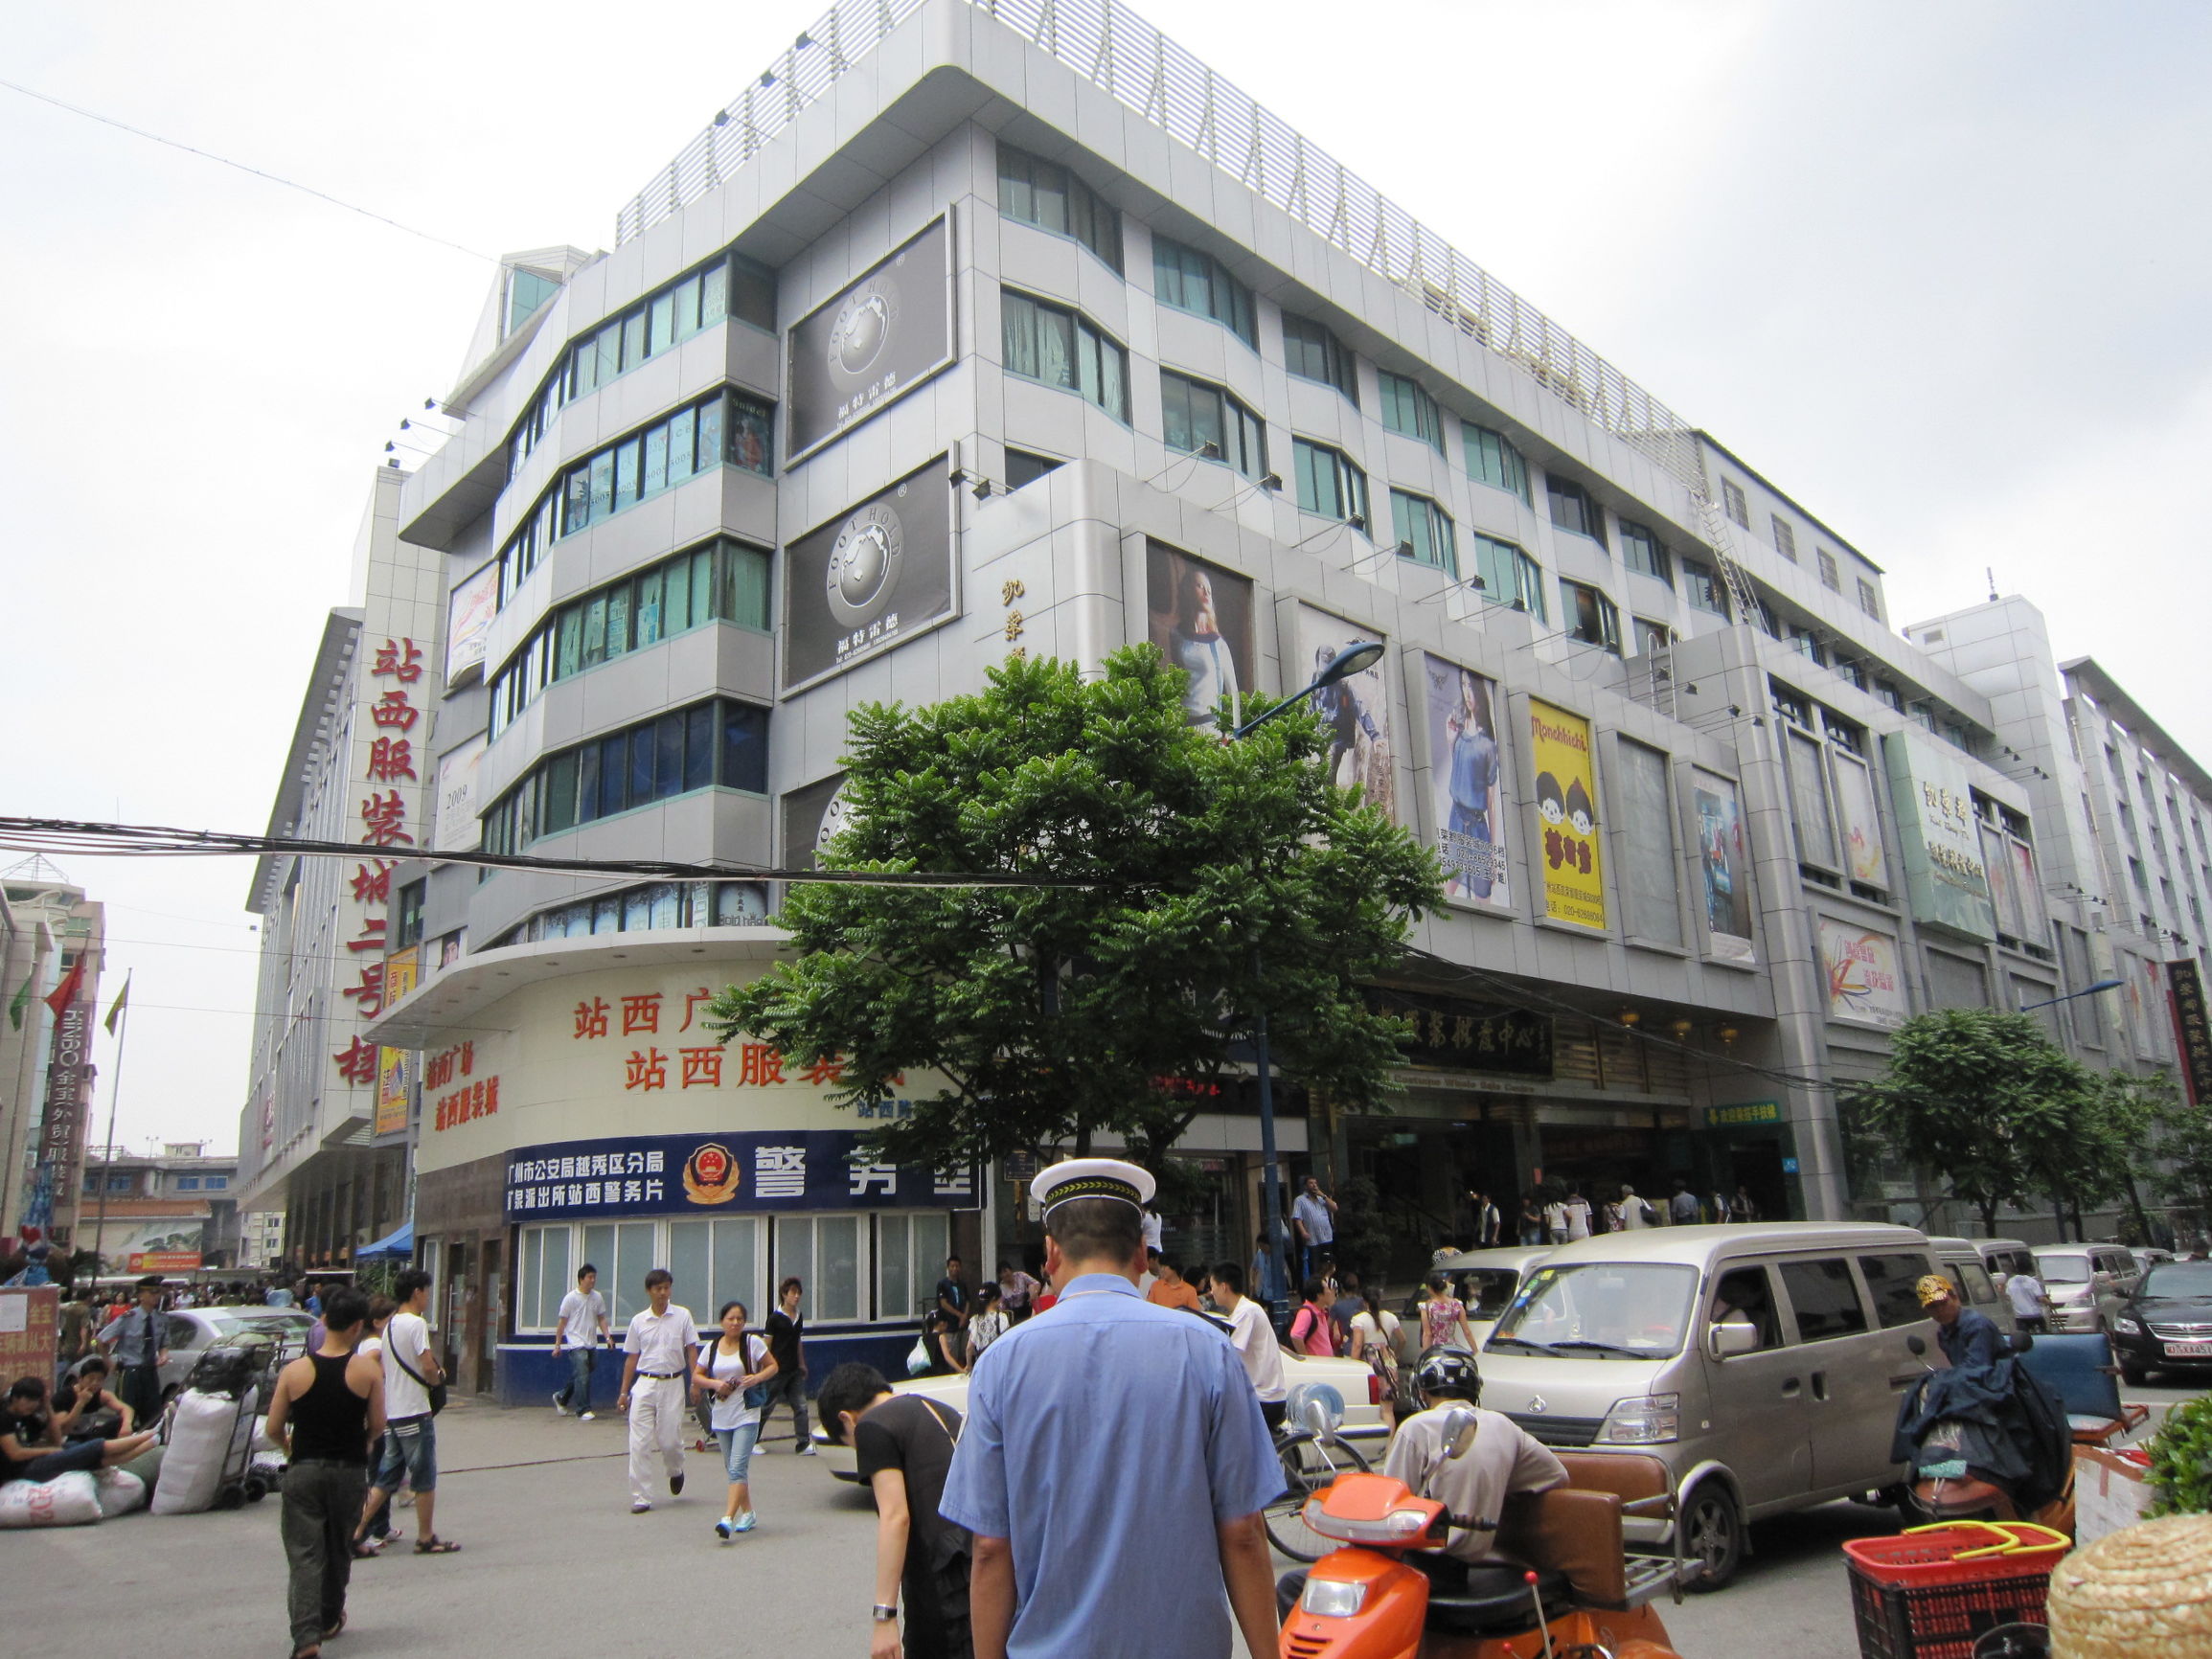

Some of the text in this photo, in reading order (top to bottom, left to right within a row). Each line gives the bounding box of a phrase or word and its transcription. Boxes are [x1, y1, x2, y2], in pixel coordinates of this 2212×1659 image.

[828, 506, 902, 592] FOOT HOLD
[836, 612, 899, 655] 福特雷德
[445, 784, 467, 810] 2009
[625, 1042, 906, 1092] 站西服装
[435, 1074, 500, 1132] 站西服装城
[508, 1150, 665, 1184] 广州市公安局越秀区分局
[507, 1178, 664, 1212] 矿泉派出所站西警务片
